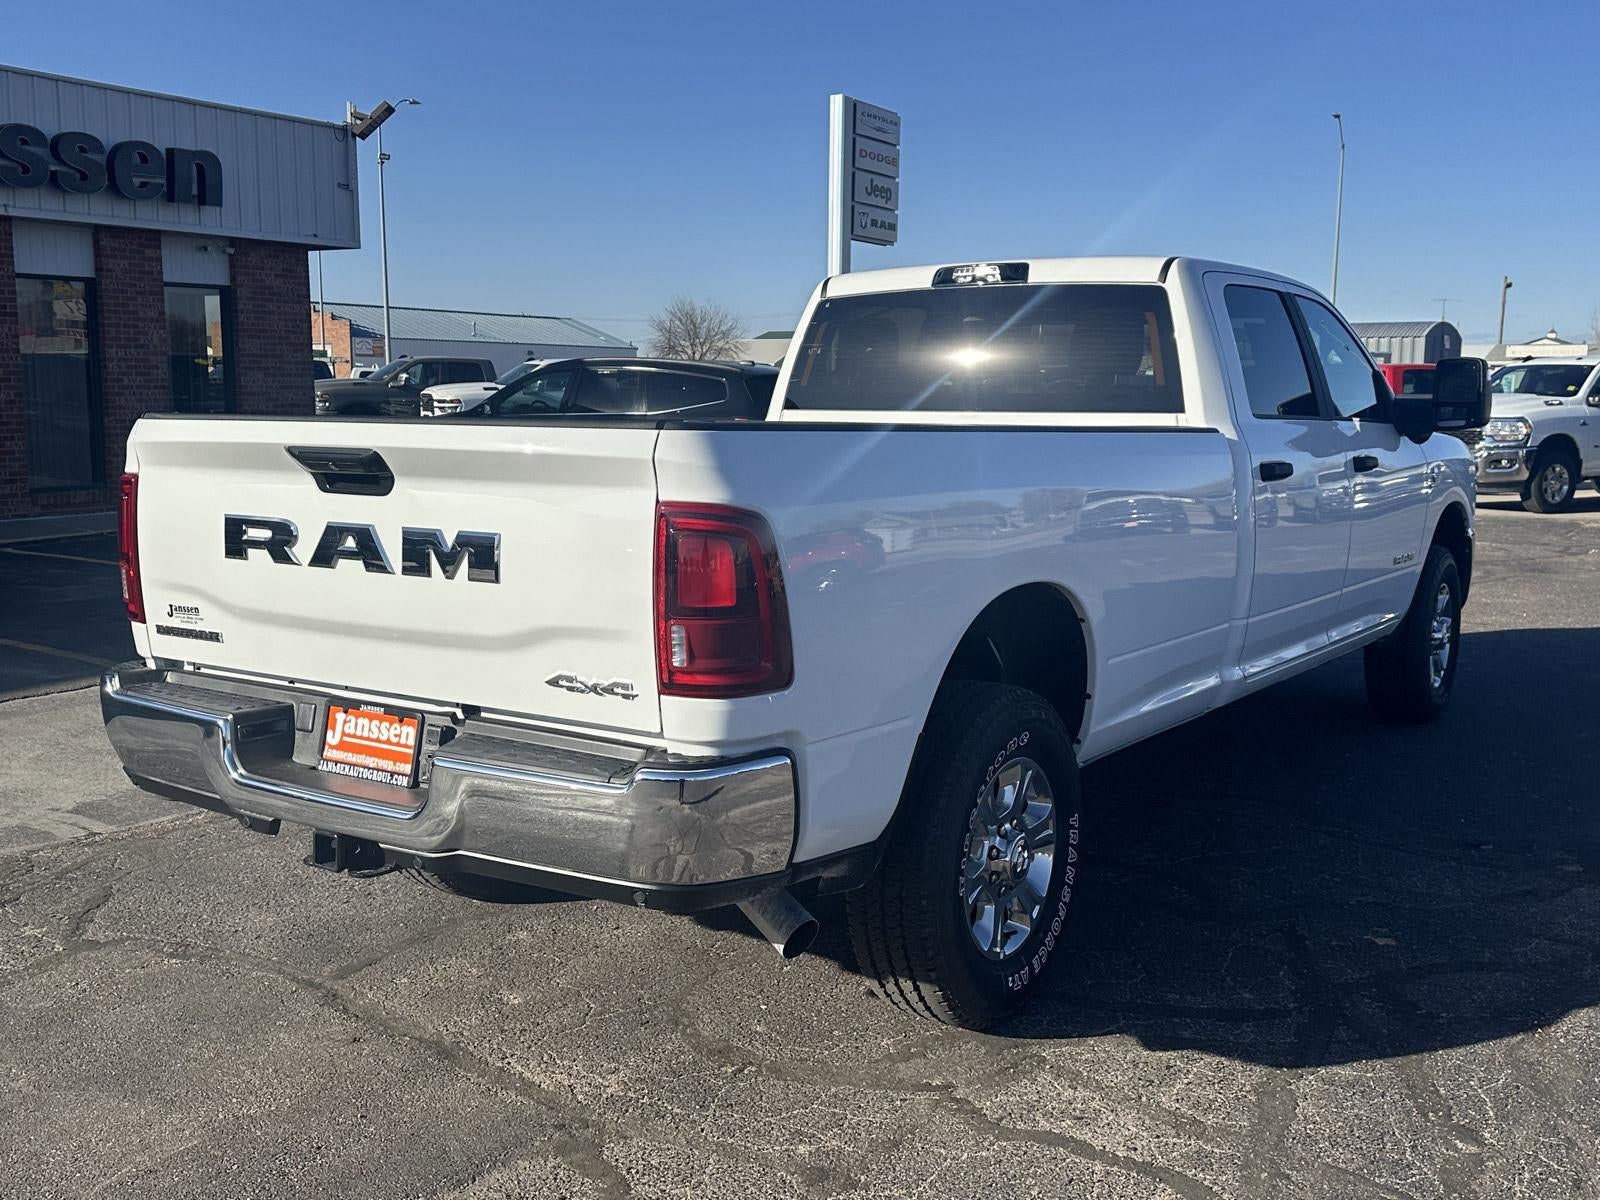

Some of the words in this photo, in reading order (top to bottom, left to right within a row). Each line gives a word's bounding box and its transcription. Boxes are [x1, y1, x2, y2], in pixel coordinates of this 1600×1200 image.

[861, 111, 898, 127] CHRYSLER
[859, 149, 897, 167] DODGE
[865, 178, 892, 203] Jeep
[871, 219, 896, 232] RAM
[224, 513, 502, 584] RAM
[167, 604, 200, 617] Janssen
[360, 704, 384, 713] JANSSEN
[326, 711, 415, 746] Janssen
[318, 760, 409, 787] JANSSENAUTOGROUP.COM
[1032, 813, 1079, 973] TRANSFORCE
